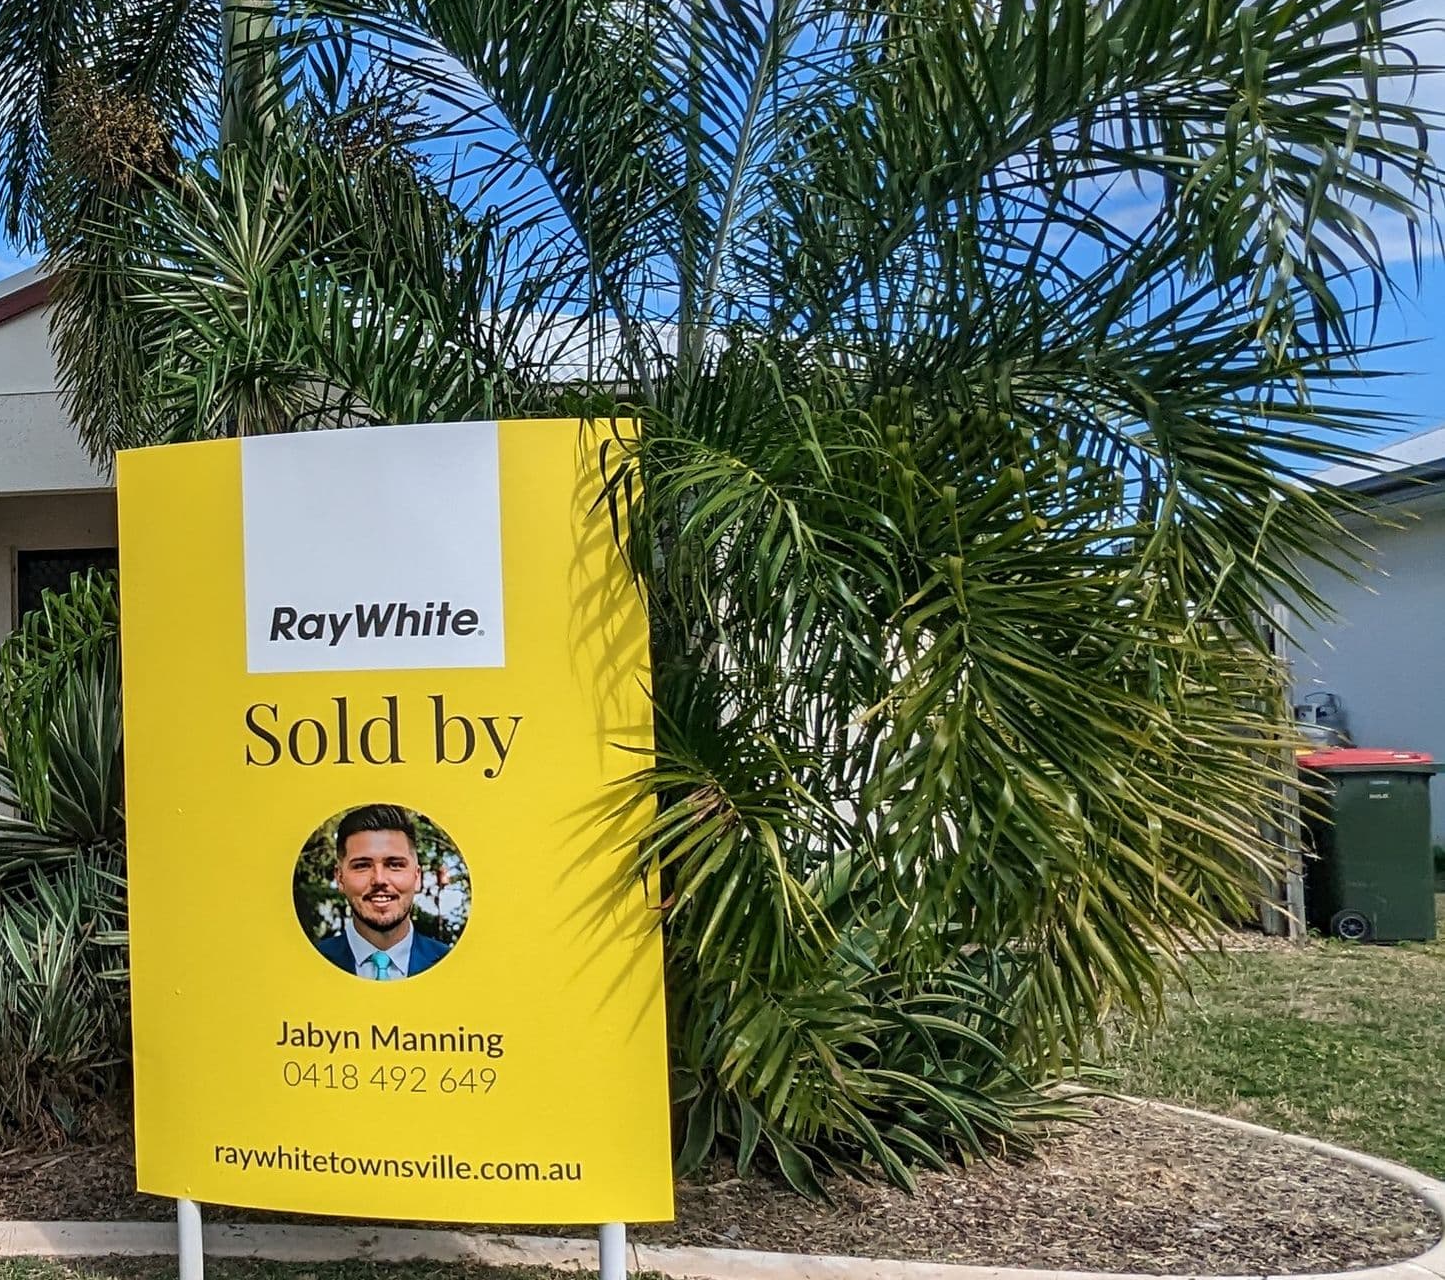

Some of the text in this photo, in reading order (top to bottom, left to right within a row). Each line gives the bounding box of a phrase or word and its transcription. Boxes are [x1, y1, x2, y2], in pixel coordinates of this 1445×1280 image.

[244, 695, 524, 779] Sold by
[276, 1021, 506, 1059] Jabyn Manning
[283, 1061, 498, 1095] 0418 492 649
[214, 1144, 582, 1182] raywhitetownsville.com.au
